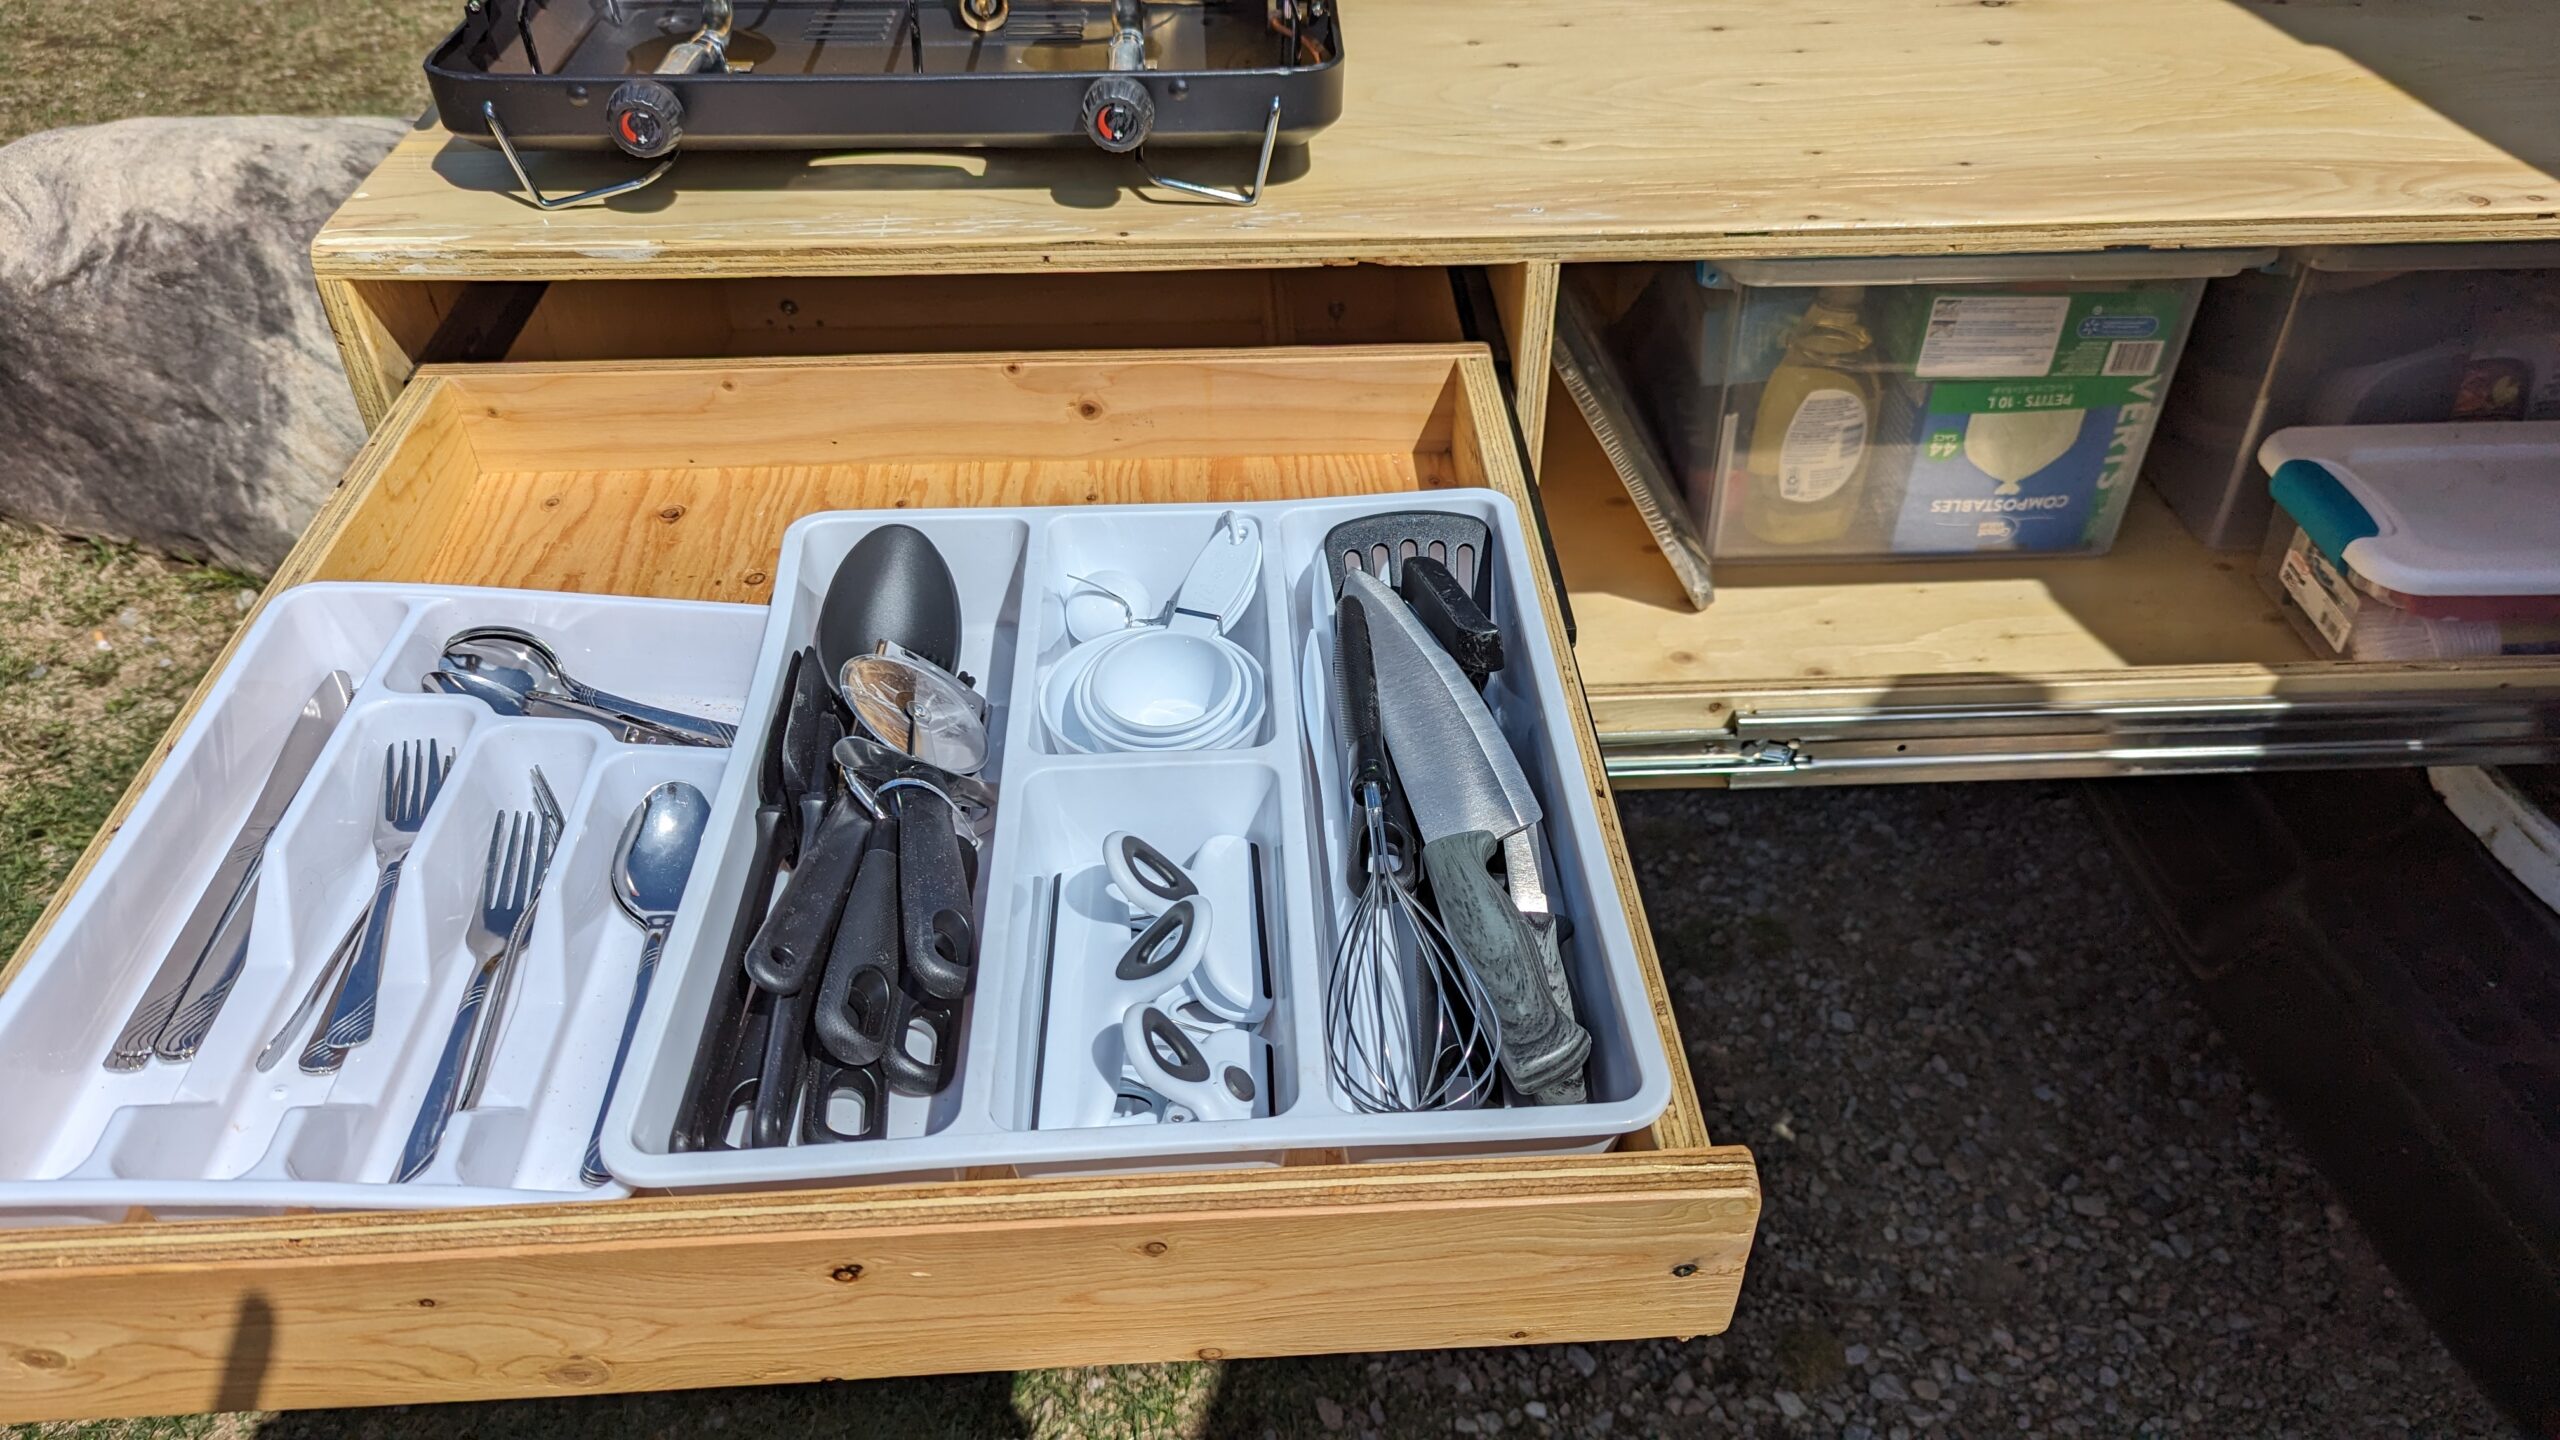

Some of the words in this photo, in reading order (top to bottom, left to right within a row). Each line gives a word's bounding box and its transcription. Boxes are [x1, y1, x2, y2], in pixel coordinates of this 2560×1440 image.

[1999, 396, 2014, 408] 10
[2025, 393, 2074, 407] PETITS
[1933, 433, 1957, 442] SACS
[1929, 442, 1957, 457] 44
[1931, 495, 2069, 512] COMPOSTABLES
